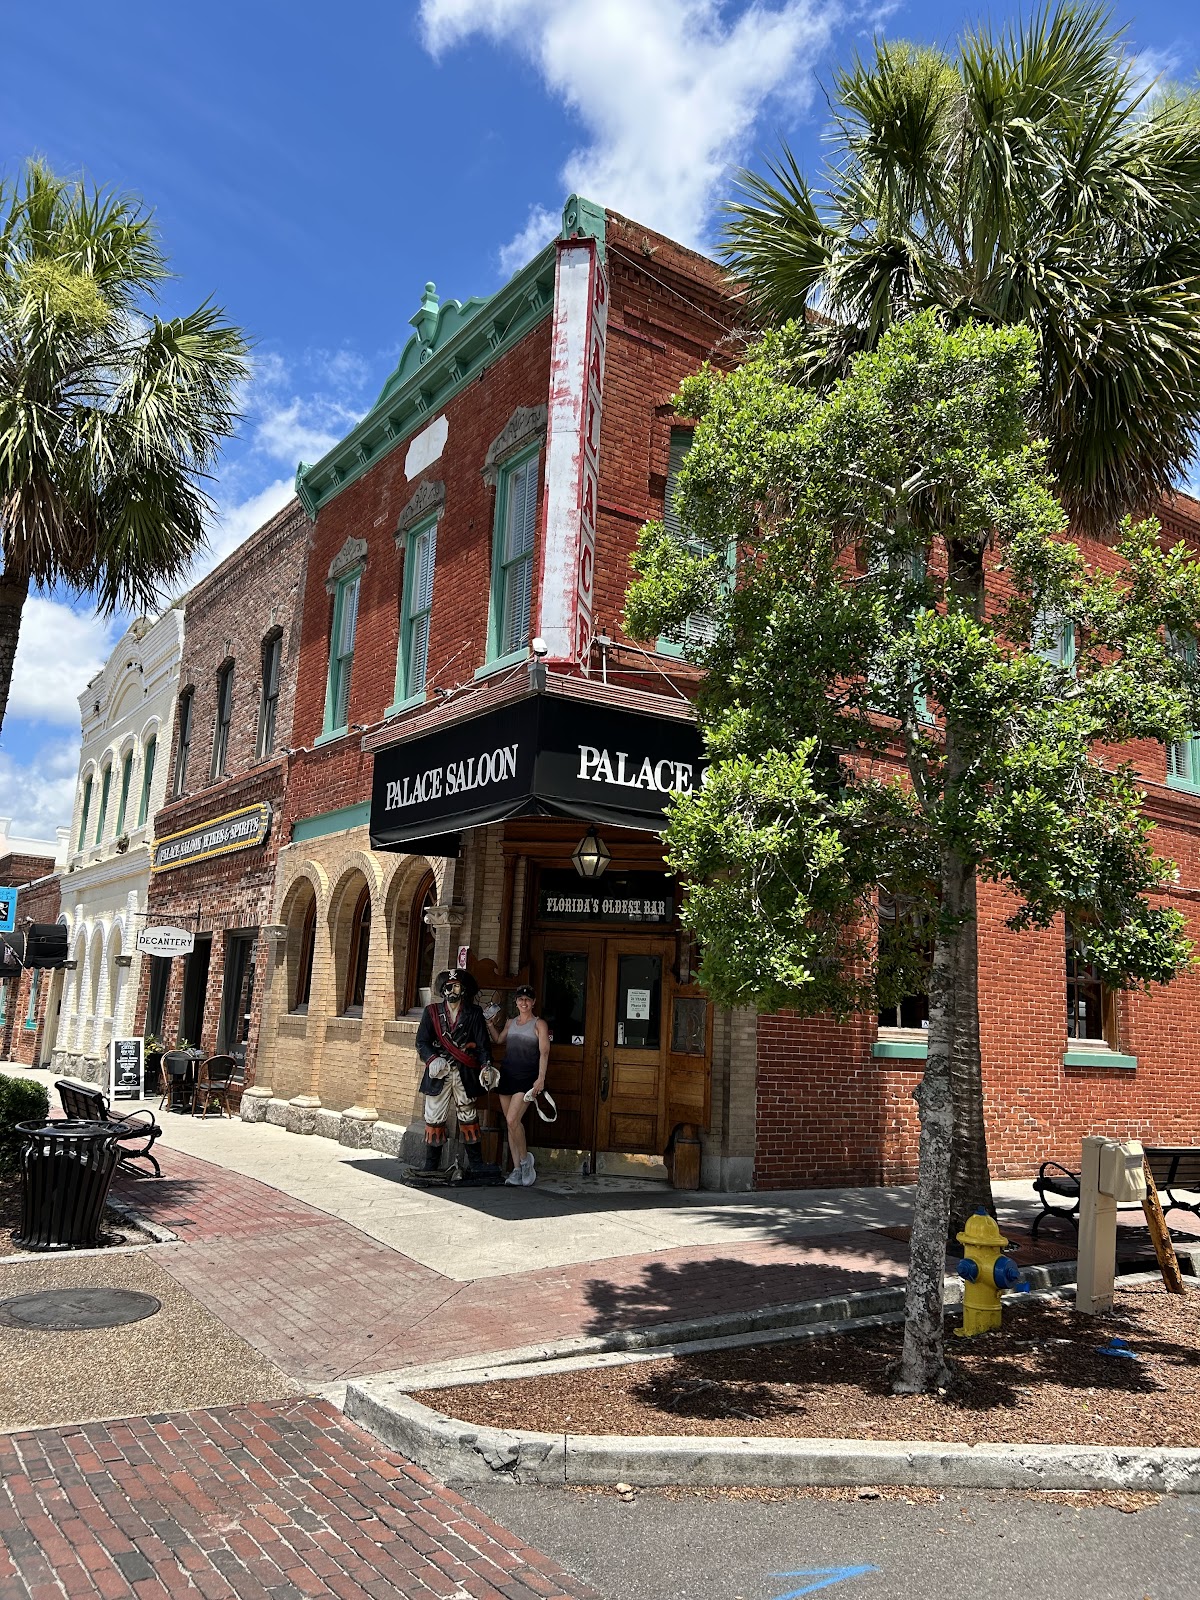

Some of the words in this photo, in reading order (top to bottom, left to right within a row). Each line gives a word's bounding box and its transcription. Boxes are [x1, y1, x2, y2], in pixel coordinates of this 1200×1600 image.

[577, 265, 606, 669] PALACE
[385, 767, 443, 811] PALACE
[445, 743, 519, 796] SALOON
[576, 744, 693, 798] PALACE
[160, 842, 180, 861] PALACE
[180, 836, 203, 855] SALOON
[203, 828, 225, 847] WINES
[229, 817, 260, 839] SPIRITS
[546, 898, 600, 913] FLORIDA'S
[601, 899, 642, 914] OLDEST
[643, 900, 666, 915] BAR
[139, 936, 193, 947] DECANTERY
